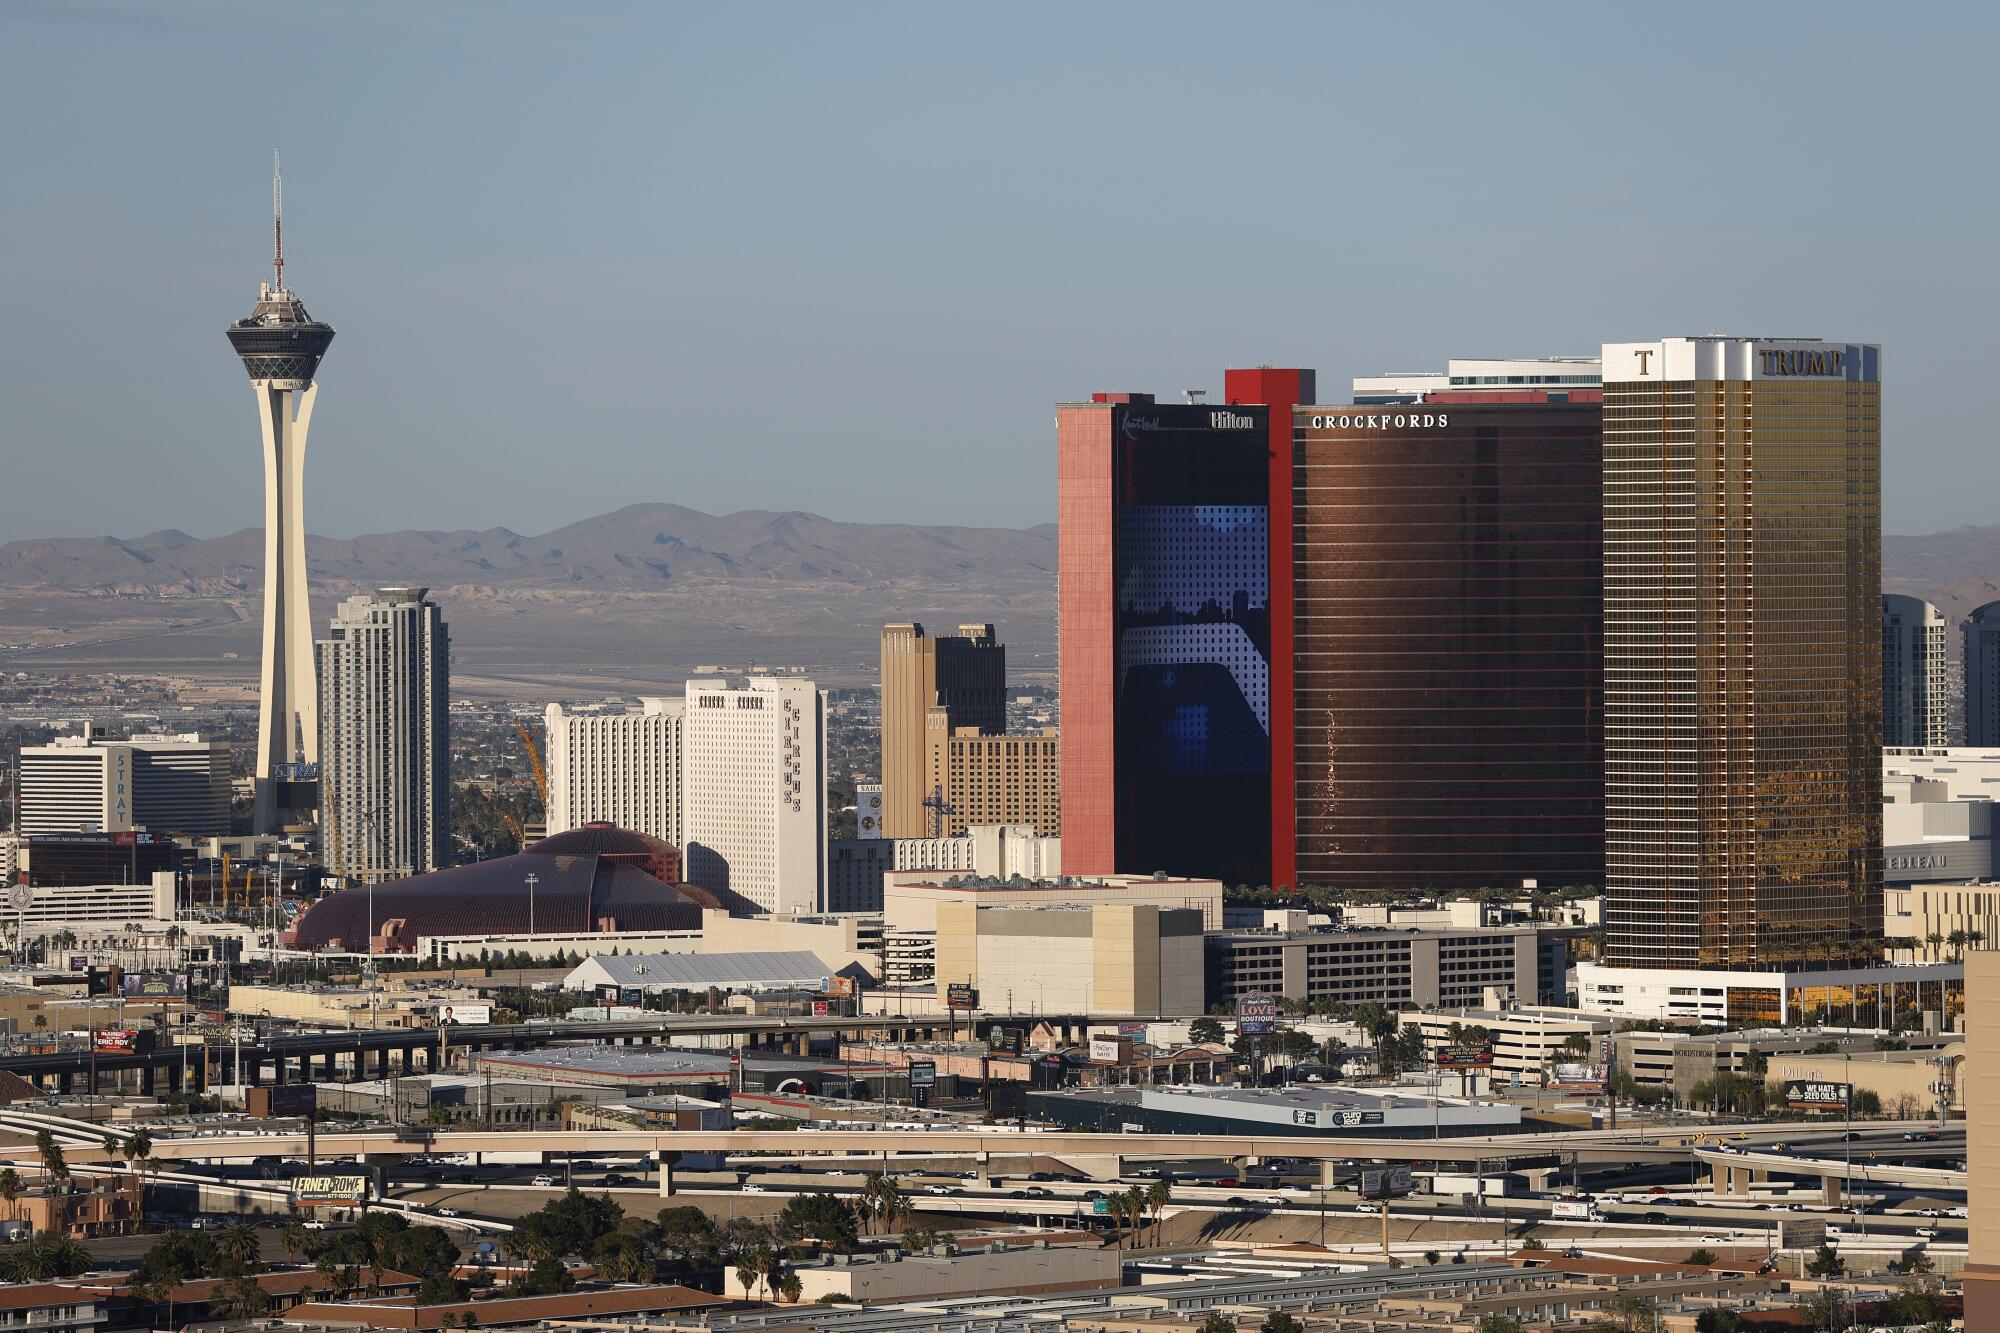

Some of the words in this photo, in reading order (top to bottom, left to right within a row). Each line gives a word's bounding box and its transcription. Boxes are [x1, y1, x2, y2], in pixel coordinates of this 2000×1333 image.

[1634, 350, 1653, 376] T
[1758, 350, 1845, 376] TRUMP
[1210, 410, 1254, 429] Hilton
[1312, 414, 1448, 430] CROCKFORDS
[784, 699, 792, 803] CIRCUS
[792, 708, 801, 813] CIRCUS
[116, 754, 126, 823] STRAT
[1241, 1004, 1274, 1015] LOVE
[1674, 1049, 1713, 1058] NORDSTROM
[1804, 1091, 1820, 1100] SEED
[1820, 1092, 1837, 1100] OILS!
[1805, 1084, 1817, 1093] WE
[1818, 1084, 1835, 1093] HATE
[1343, 1117, 1361, 1125] leaf
[292, 1177, 330, 1192] LERNER
[333, 1177, 361, 1192] ROWE
